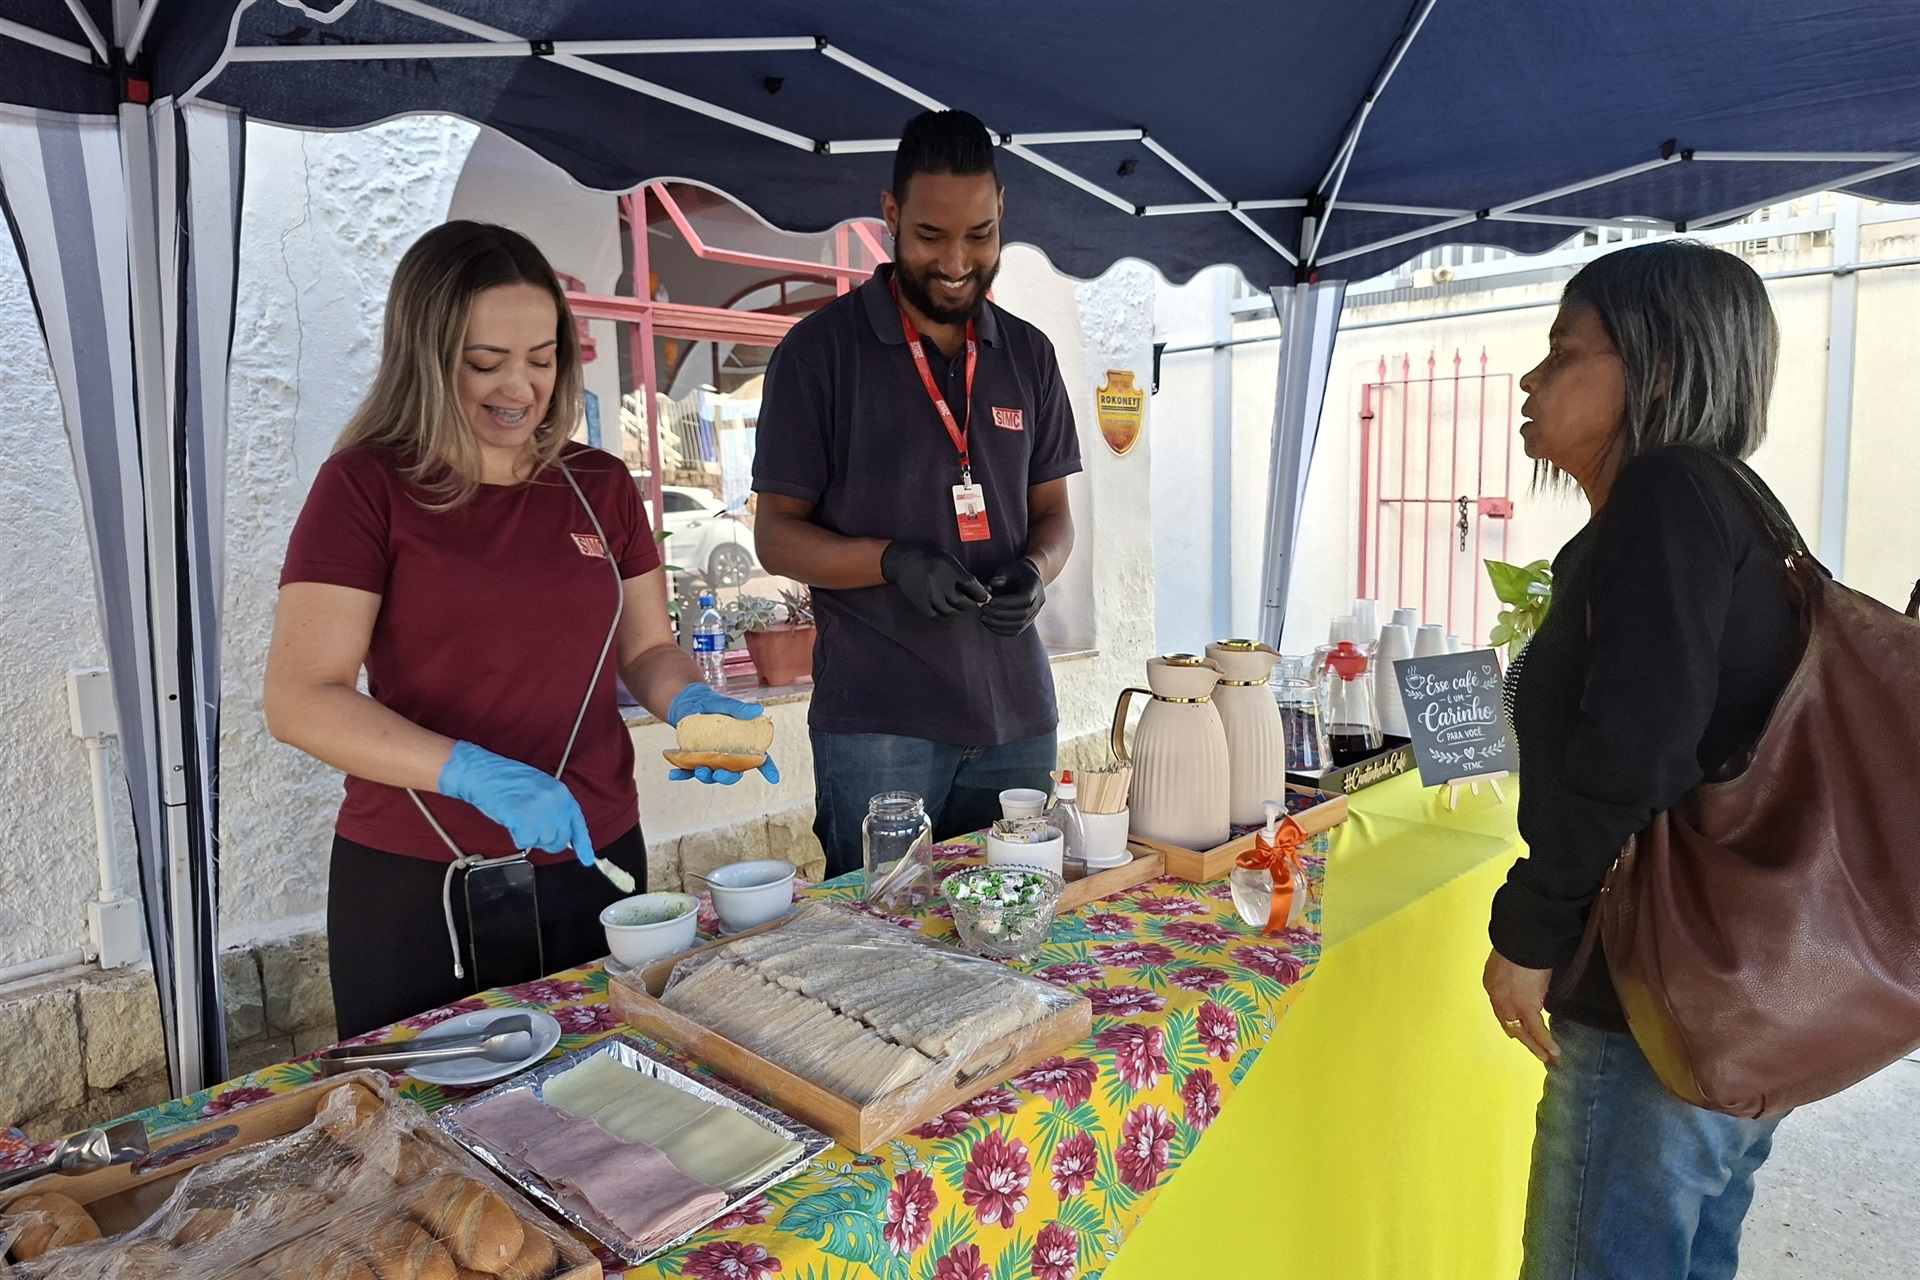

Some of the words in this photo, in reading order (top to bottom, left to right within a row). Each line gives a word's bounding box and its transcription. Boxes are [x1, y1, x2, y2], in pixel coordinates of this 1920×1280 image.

[1101, 395, 1136, 406] ROKONEY
[996, 410, 1020, 428] SIMC
[1426, 674, 1450, 696] Esse
[1452, 669, 1480, 694] café
[1453, 694, 1465, 703] UM
[1418, 696, 1496, 732] Carinho
[1446, 730, 1464, 741] PARA
